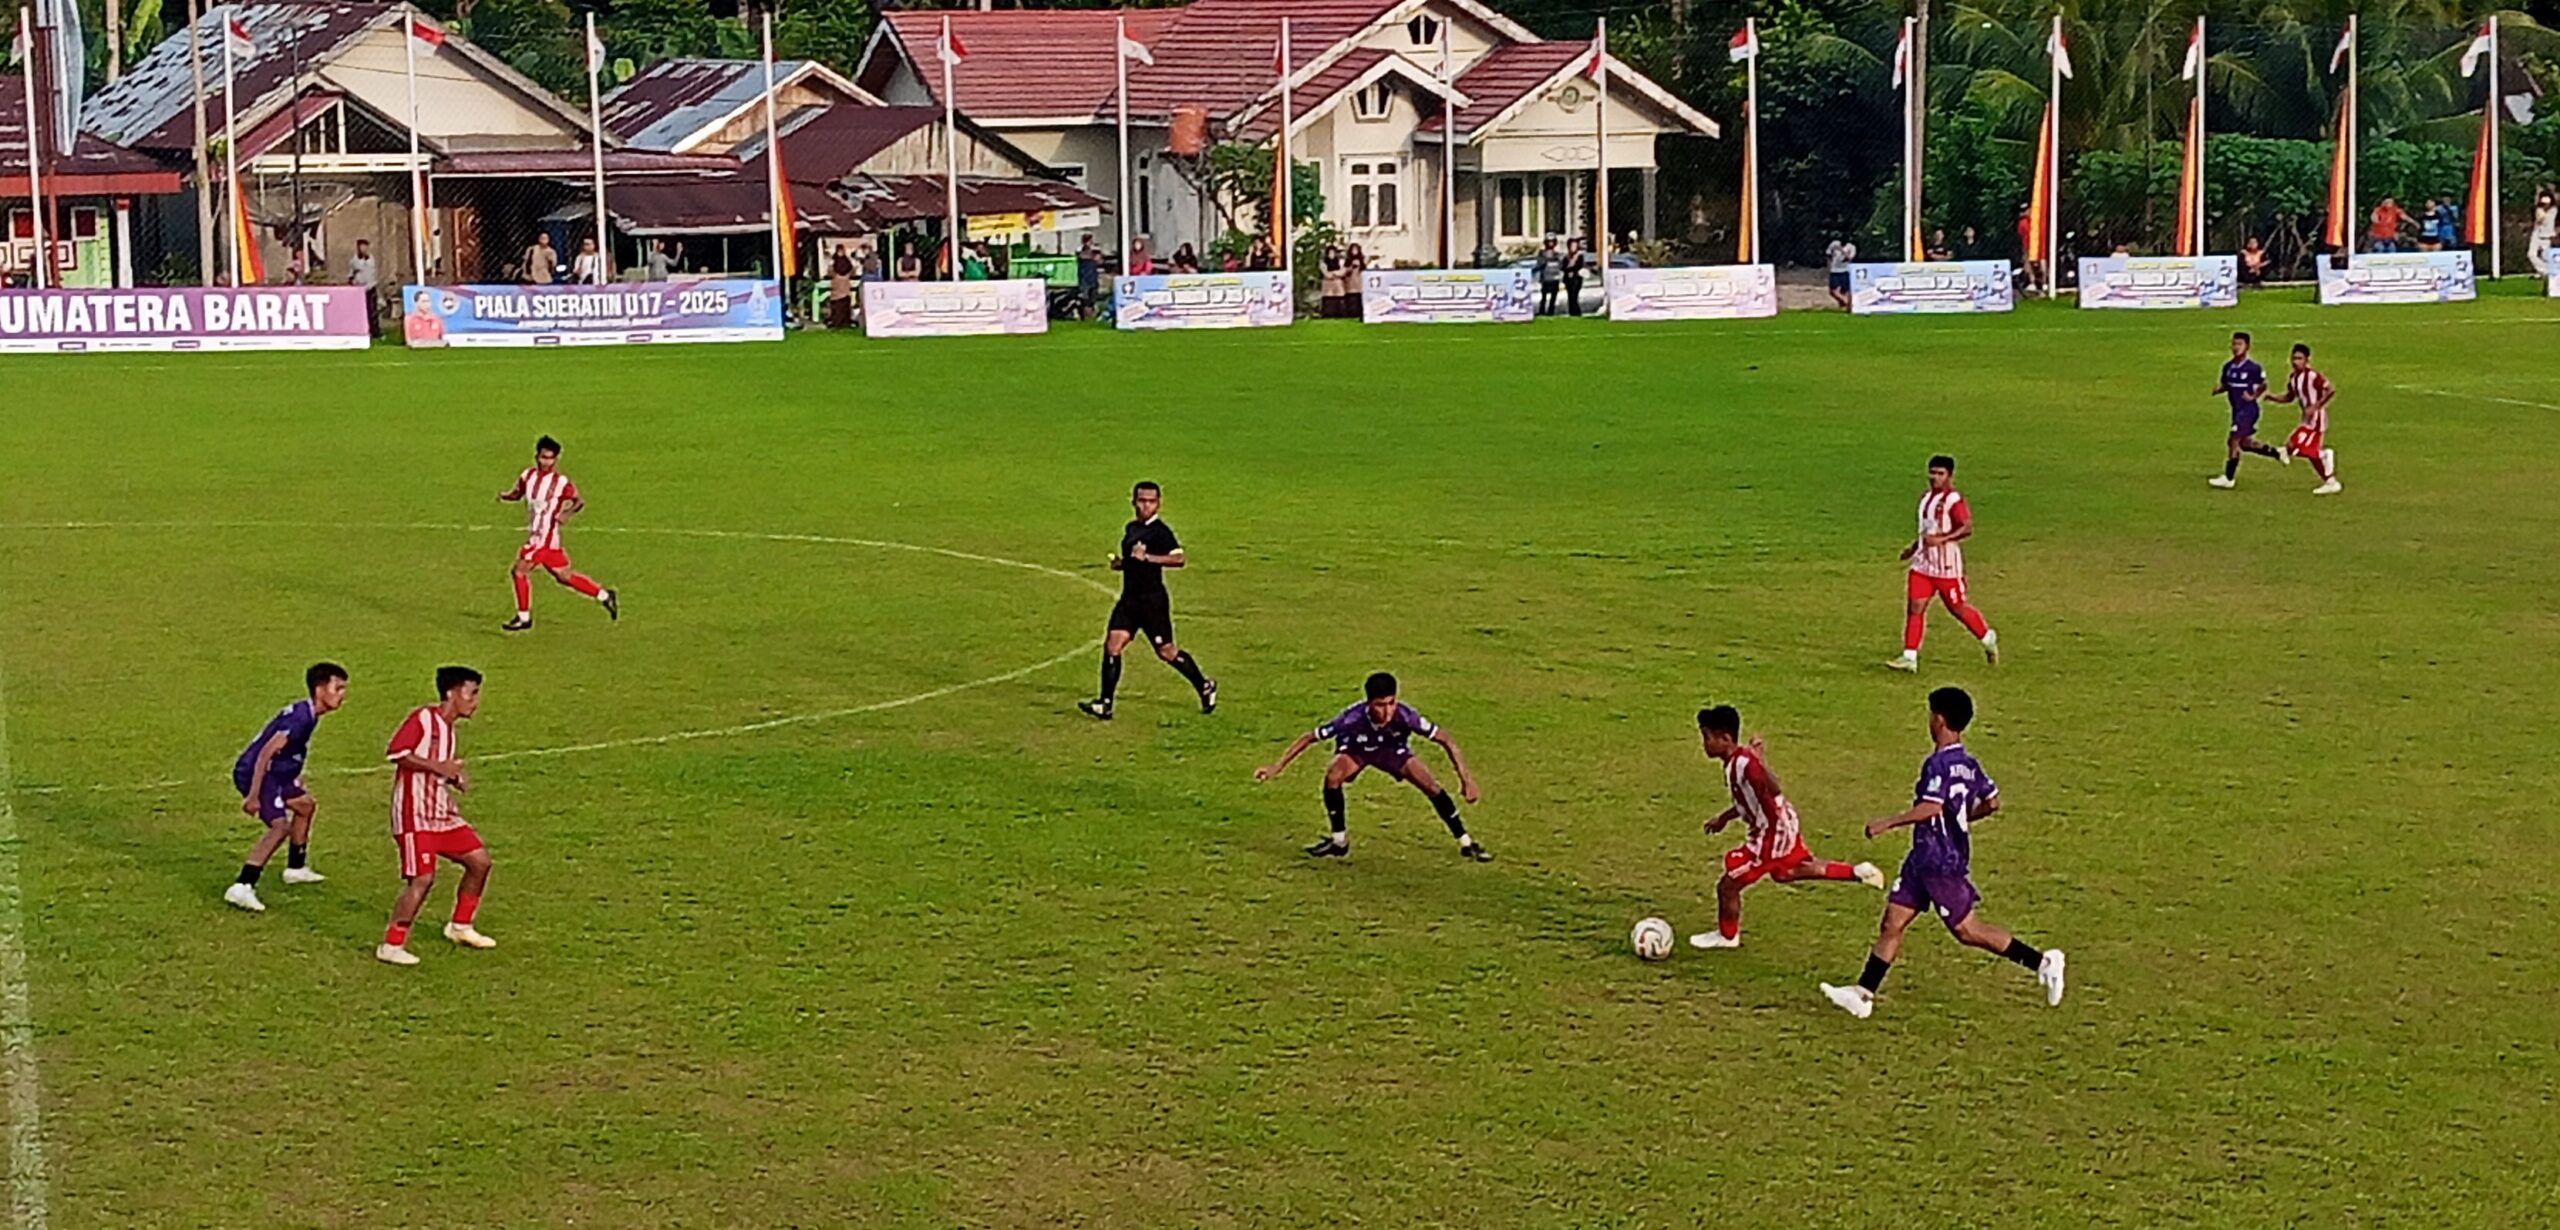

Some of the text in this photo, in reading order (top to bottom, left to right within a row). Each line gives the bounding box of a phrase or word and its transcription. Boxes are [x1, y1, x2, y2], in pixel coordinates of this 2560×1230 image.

[203, 294, 330, 331] BARAT
[475, 296, 529, 318] PIALA
[532, 293, 622, 317] SOERATIN
[625, 292, 662, 315] U17
[679, 290, 729, 314] 2025
